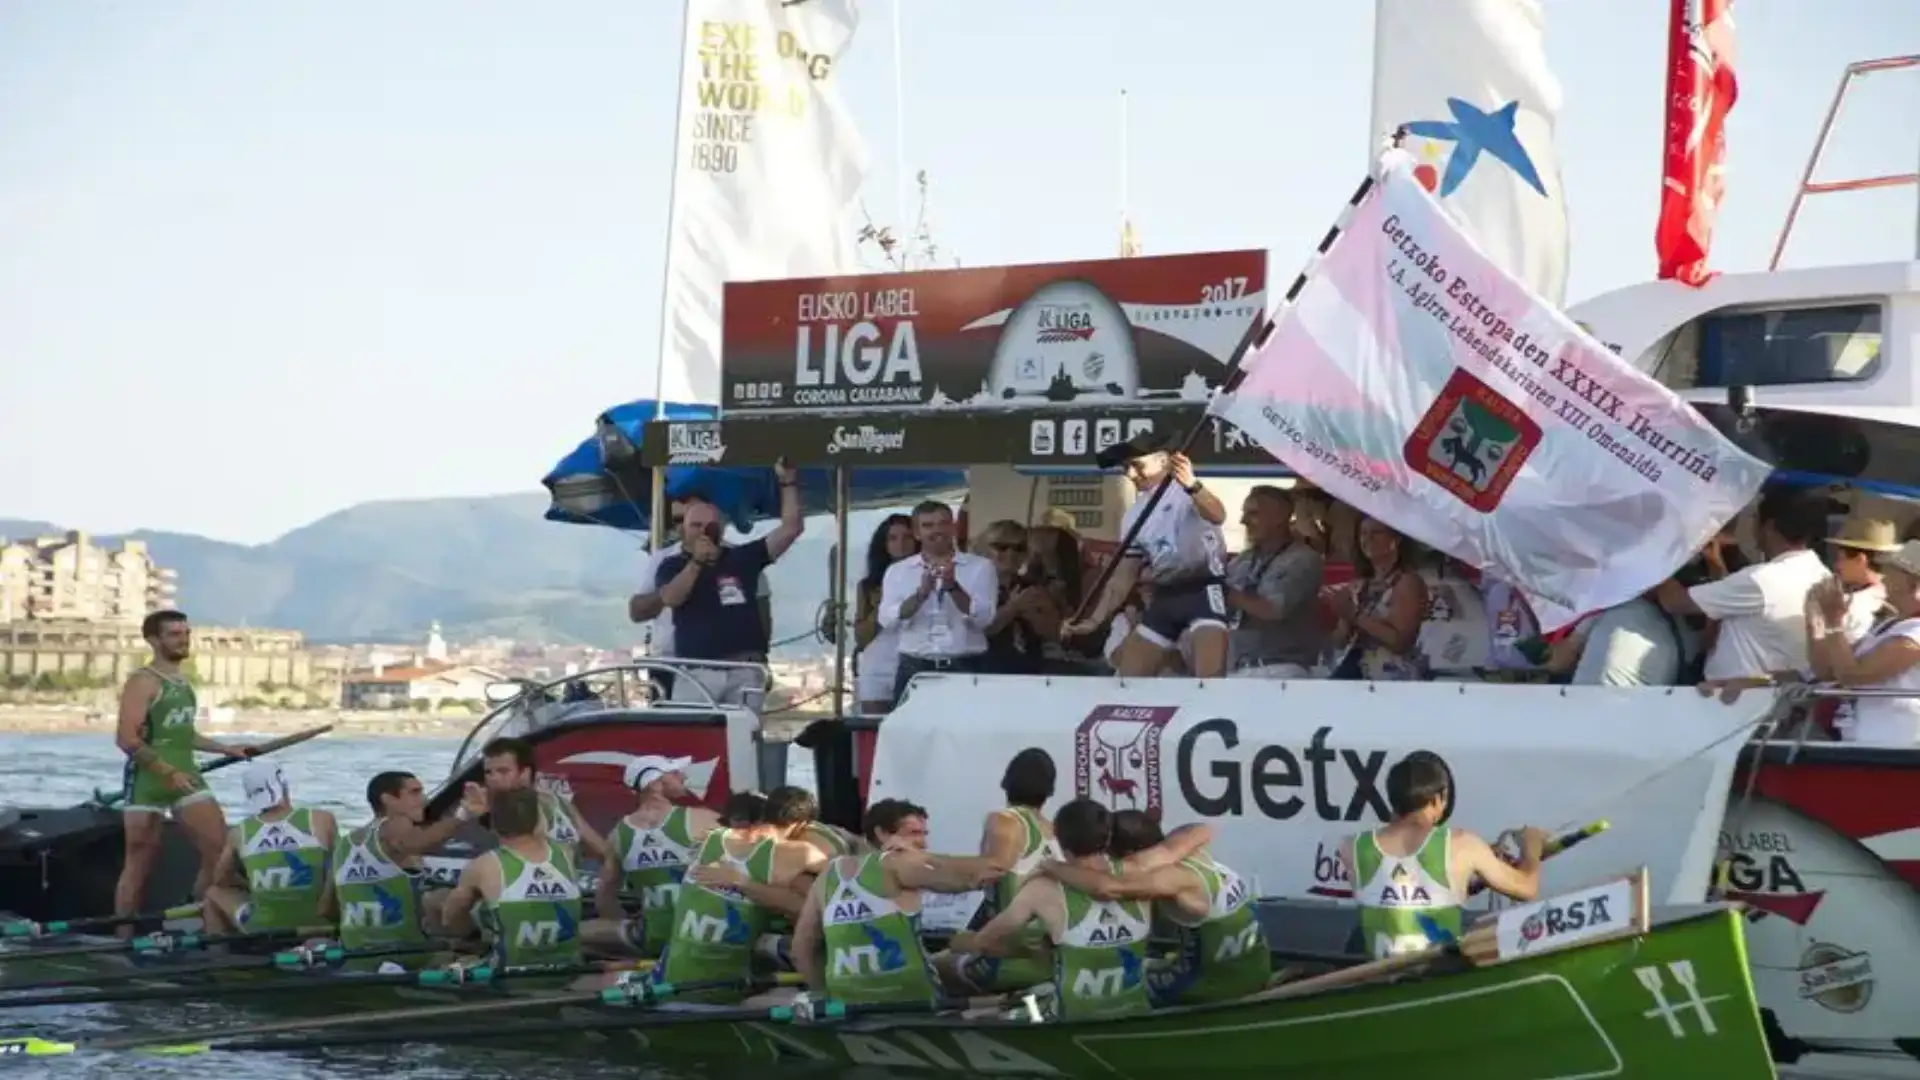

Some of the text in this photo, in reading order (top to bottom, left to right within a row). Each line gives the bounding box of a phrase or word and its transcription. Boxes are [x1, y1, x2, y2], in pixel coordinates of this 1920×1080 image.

[693, 113, 754, 142] SINCE
[691, 144, 738, 173] 1890
[1200, 277, 1249, 304] 2017
[798, 288, 919, 321] EUSKO LABEL
[795, 321, 922, 385] LIGA
[1382, 214, 1448, 284] Getxoko
[1445, 276, 1550, 369] Estropaden
[1626, 412, 1718, 482] Ikurriña
[1405, 282, 1451, 323] Agirre
[1554, 400, 1591, 431] XIII
[1587, 423, 1664, 483] Omenaldia
[794, 385, 922, 405] CORONA CAIXABANK
[1738, 831, 1798, 853] LABEL
[636, 848, 681, 867] AIA
[525, 881, 567, 896] AIA
[1380, 883, 1433, 905] AIA
[833, 900, 873, 919] AIA
[1088, 924, 1134, 944] AIA
